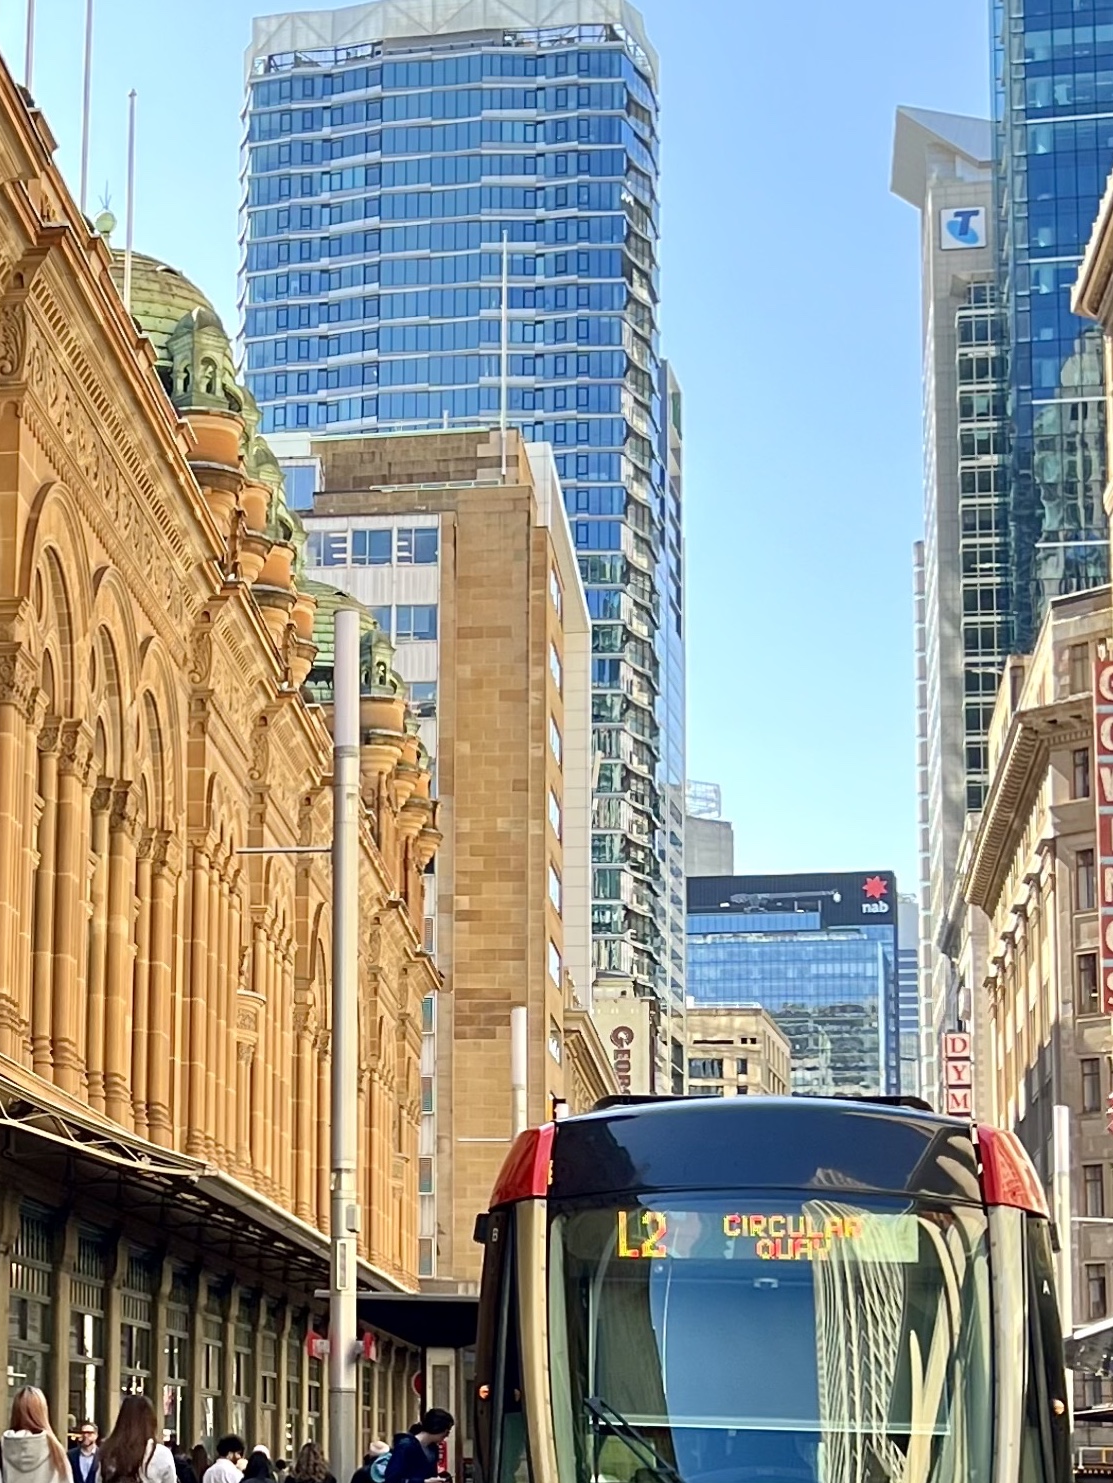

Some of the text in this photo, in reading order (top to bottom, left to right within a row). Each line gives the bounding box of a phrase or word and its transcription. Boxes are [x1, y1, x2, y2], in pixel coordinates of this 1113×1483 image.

[862, 902, 889, 914] nab
[617, 1210, 863, 1258] L2 CIRCULAR
[755, 1238, 831, 1261] QUAY
[1042, 1280, 1051, 1295] A
